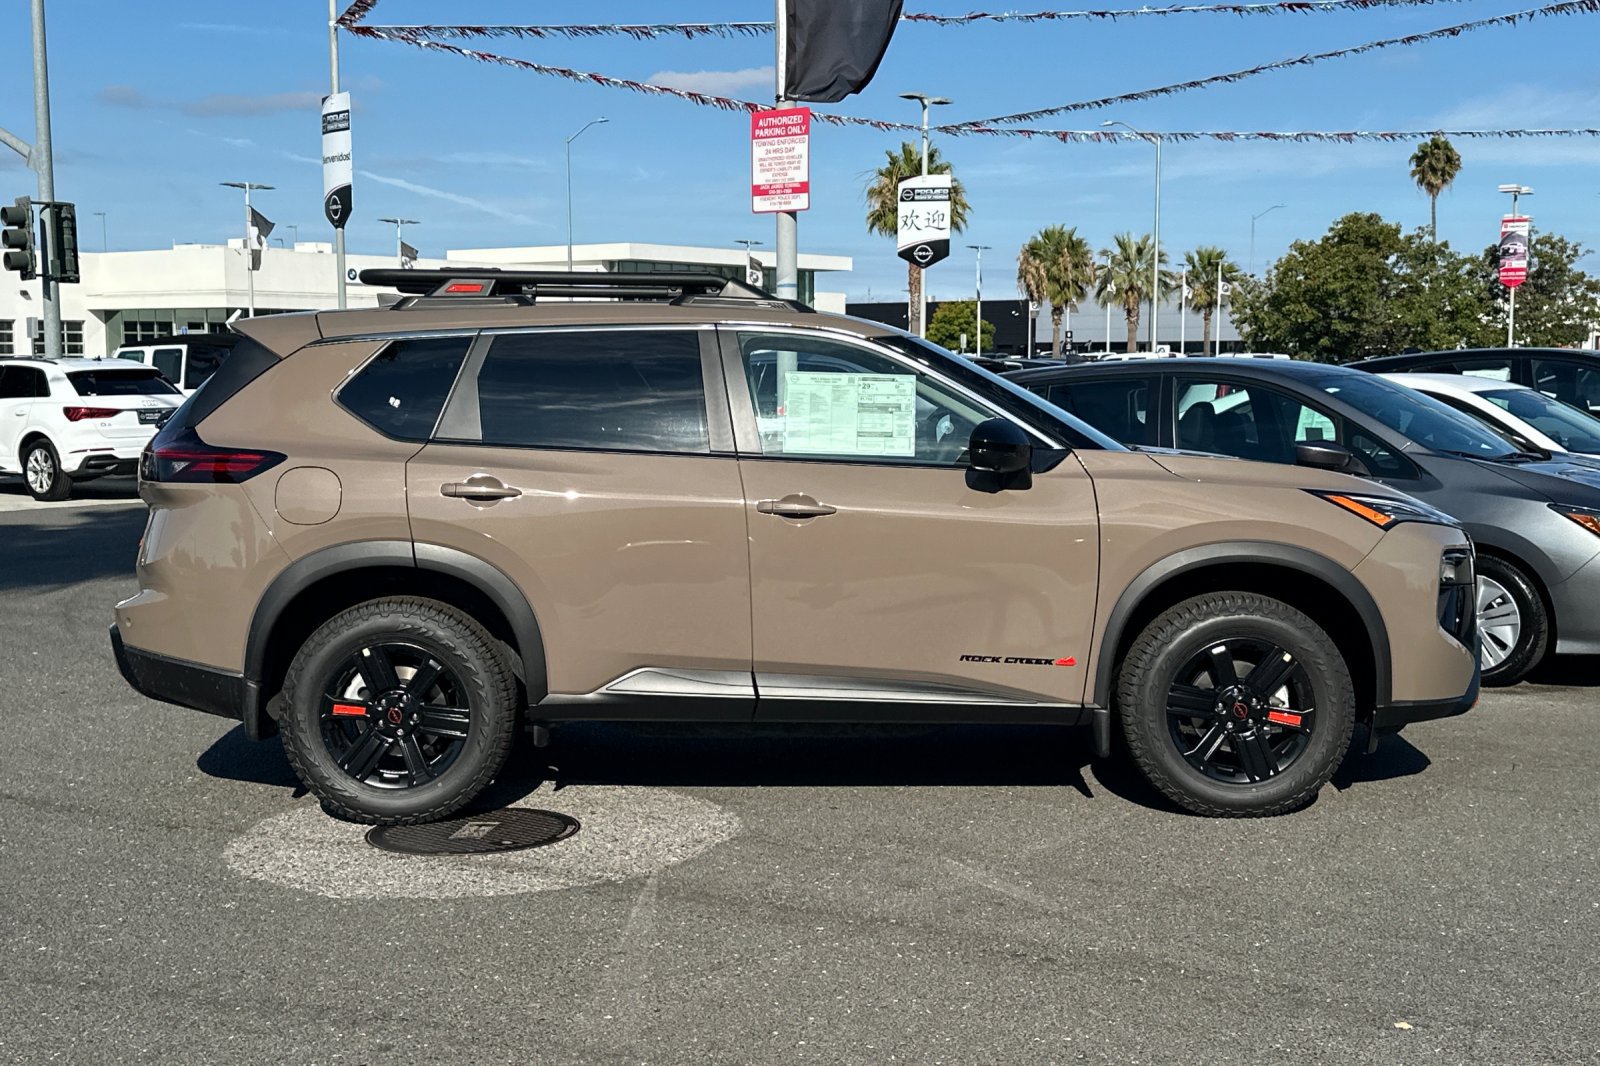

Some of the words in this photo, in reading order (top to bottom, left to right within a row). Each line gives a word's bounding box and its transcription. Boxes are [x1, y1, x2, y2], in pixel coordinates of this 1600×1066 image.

[758, 115, 804, 127] AUTHORIZED
[755, 127, 786, 138] PARKING
[787, 125, 807, 135] ONLY
[777, 137, 807, 146] ENFORCED
[900, 209, 947, 231] 欢迎
[960, 655, 1002, 663] ROCK
[1004, 657, 1054, 666] CREEK
